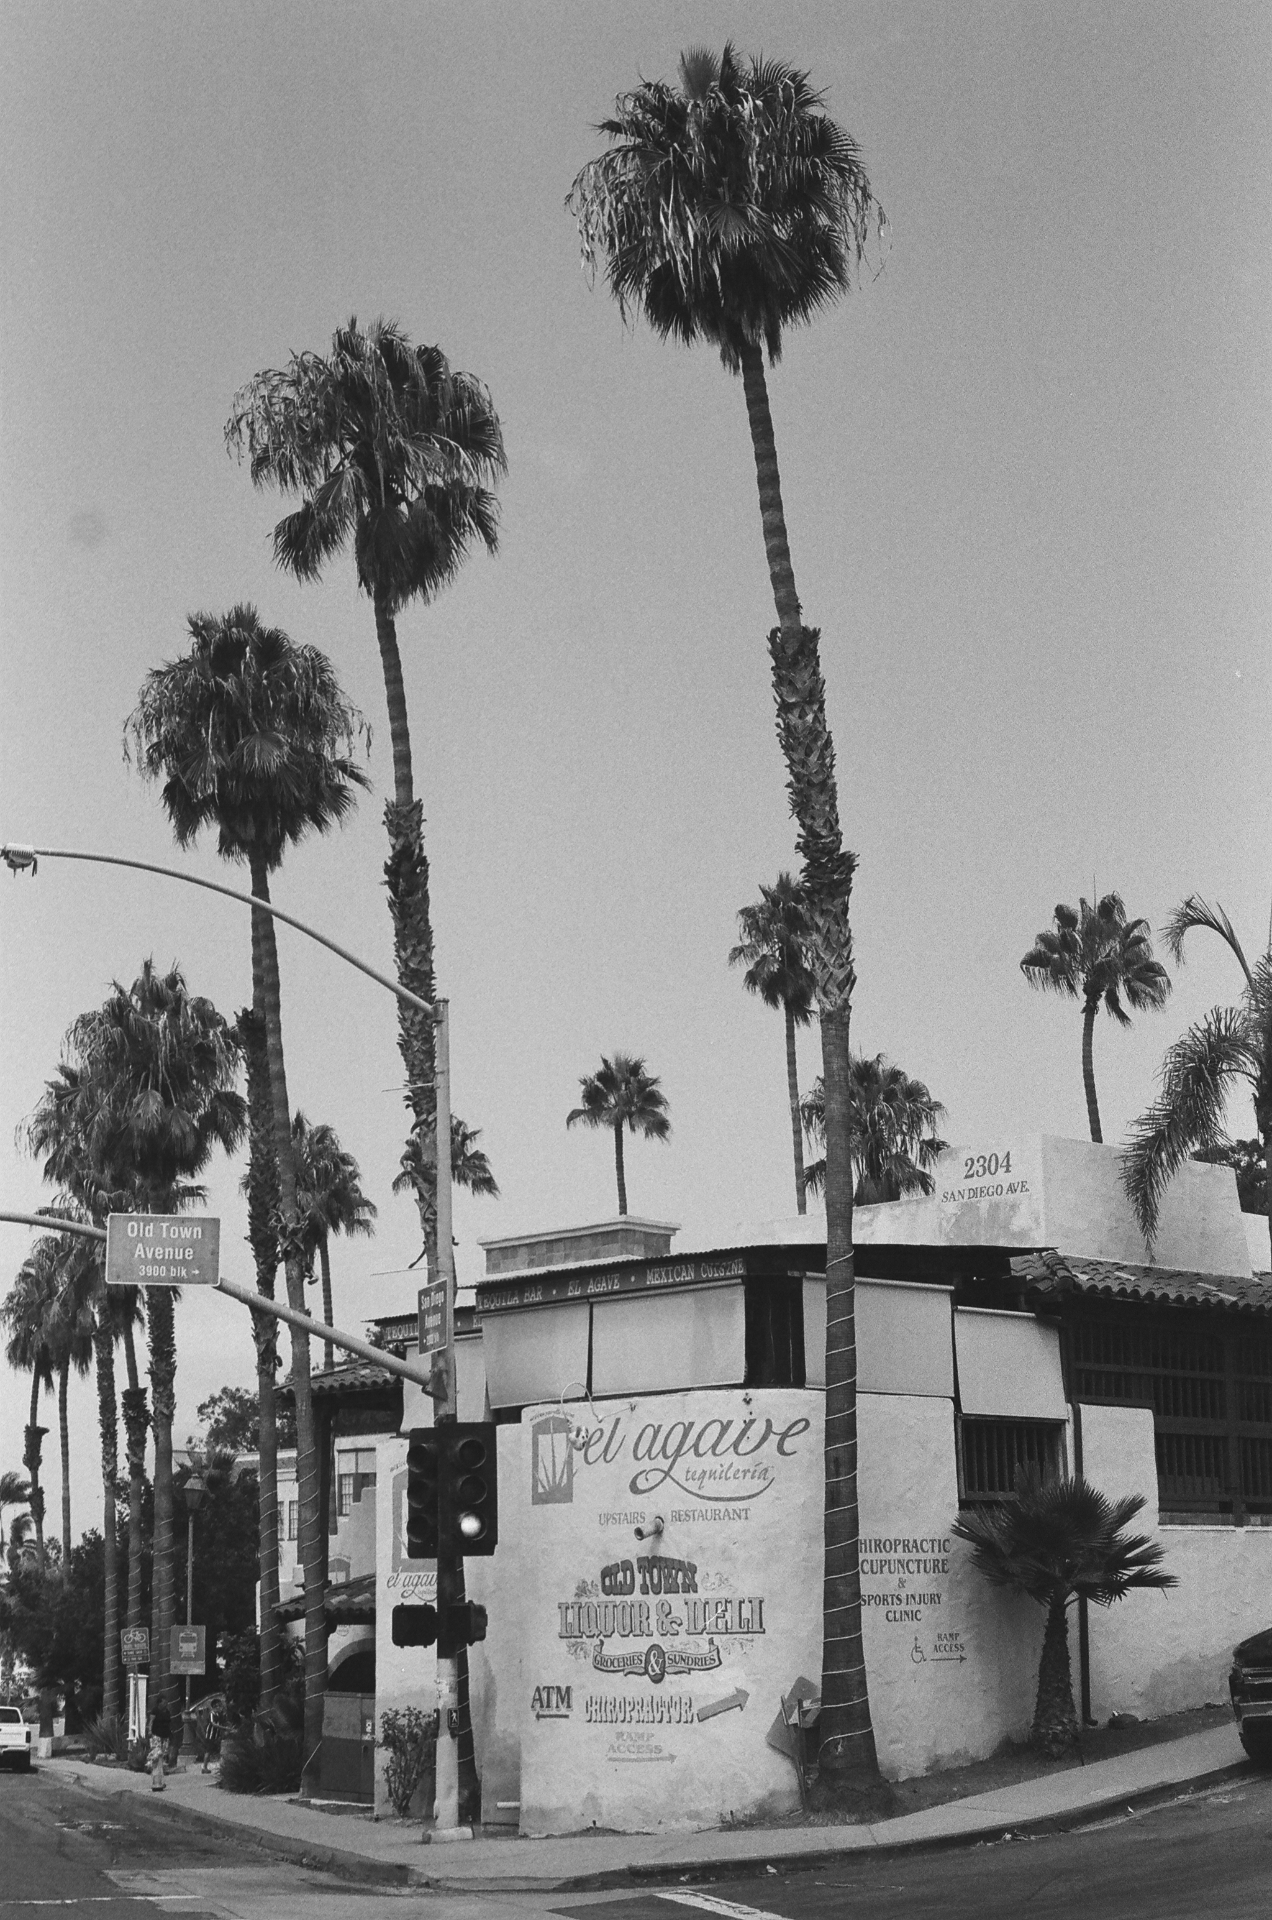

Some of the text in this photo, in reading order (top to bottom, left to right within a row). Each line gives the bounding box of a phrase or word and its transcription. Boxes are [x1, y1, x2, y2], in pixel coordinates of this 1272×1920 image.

[963, 1150, 1012, 1180] 2304
[941, 1180, 1030, 1203] SAN DIEGO AVE.
[127, 1221, 202, 1239] Old Town
[134, 1243, 194, 1260] Avenue
[139, 1265, 187, 1279] 3900 blk
[477, 1258, 744, 1310] TEQUILA BAR EL AGAVE MEXICAN CUISINE
[386, 1322, 419, 1340] TEQUIL
[583, 1417, 810, 1501] el agave
[599, 1508, 751, 1526] UPSTAIRS RESTAURANT
[858, 1538, 951, 1554] HIROPRACTIC
[601, 1555, 698, 1596] OLD TOWN
[859, 1558, 950, 1575] CUPUNCTURE
[386, 1566, 402, 1588] el
[897, 1577, 907, 1589] &
[860, 1593, 943, 1607] SPORTS INJURY
[558, 1597, 766, 1639] LIQUOR & DELI
[885, 1609, 922, 1622] CLINIC
[937, 1632, 960, 1642] RAMP
[933, 1643, 965, 1653] ACCESS
[593, 1650, 717, 1676] GROCERIES & SUNDRIES
[531, 1685, 574, 1712] ATM
[585, 1695, 694, 1724] CHIROPRACTOR
[615, 1731, 655, 1742] RAMP
[607, 1744, 663, 1754] ACCESS
